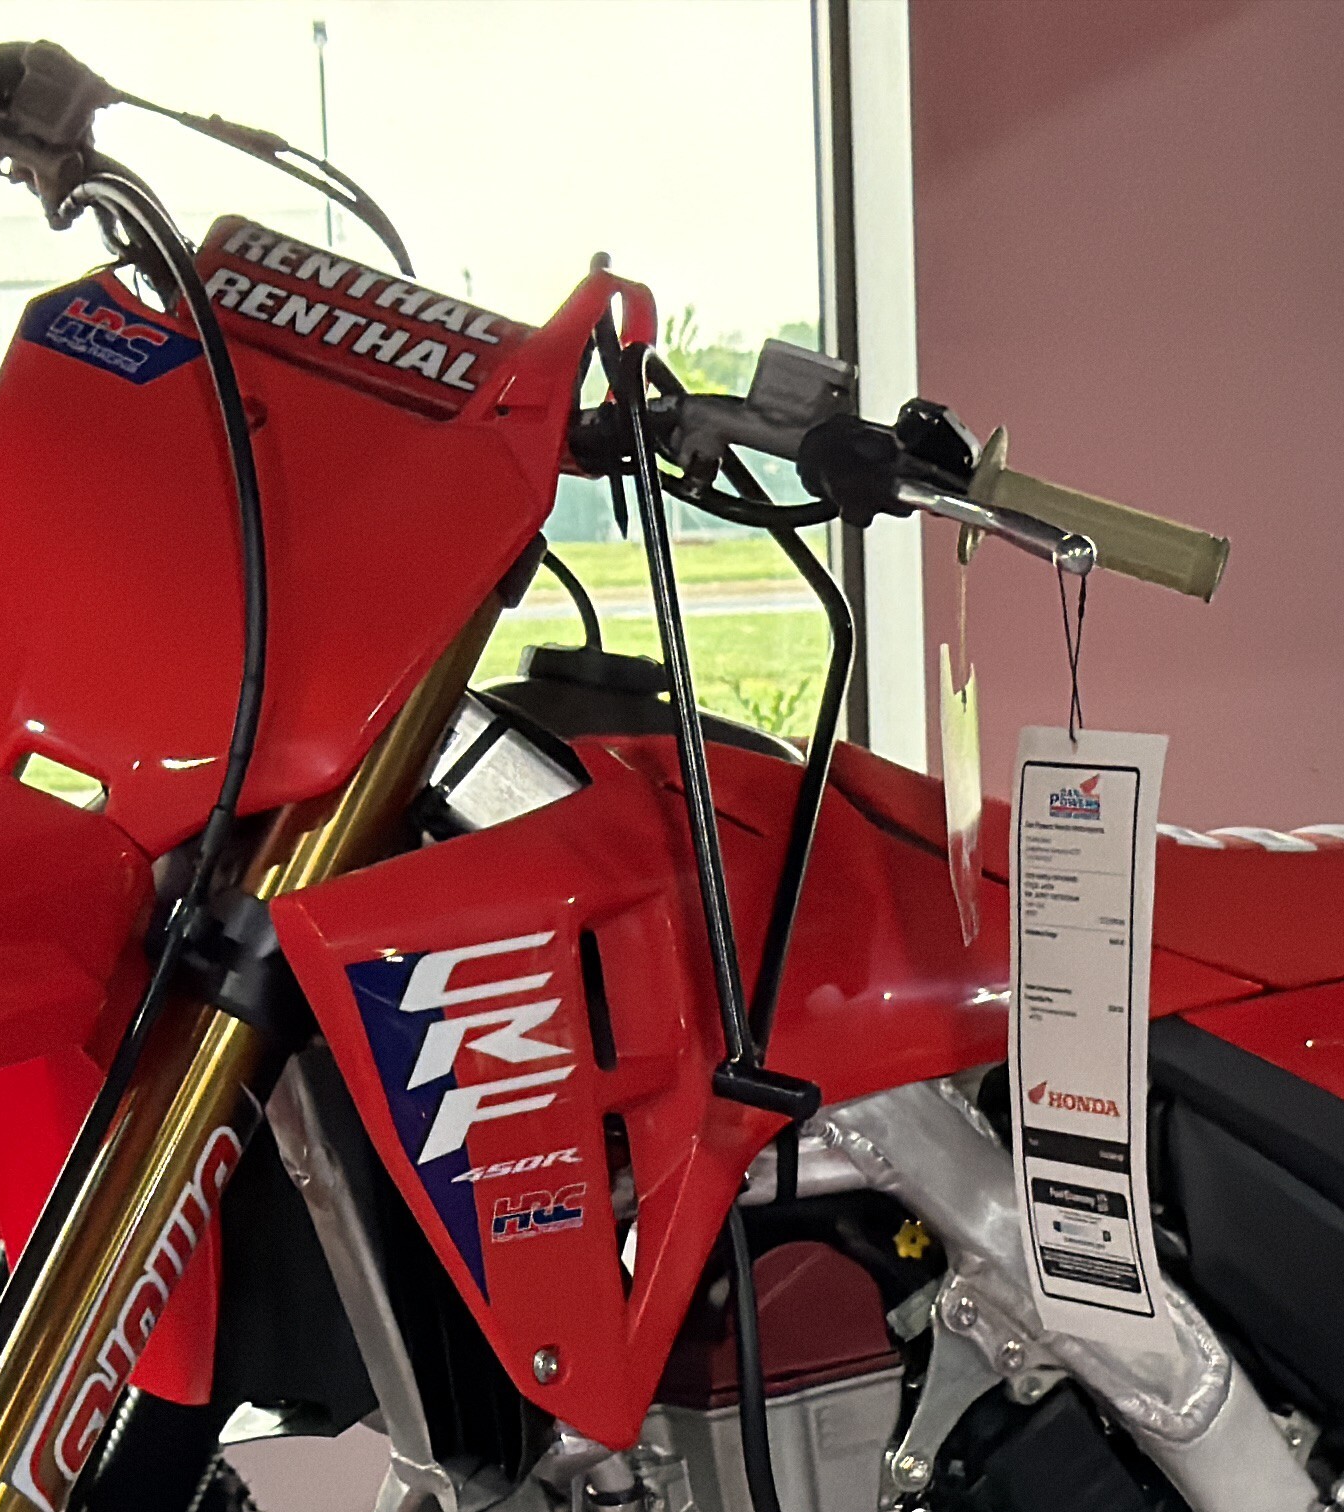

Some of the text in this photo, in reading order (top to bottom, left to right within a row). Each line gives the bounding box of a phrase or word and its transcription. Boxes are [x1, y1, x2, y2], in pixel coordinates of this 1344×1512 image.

[222, 224, 500, 345] RENTHAL
[46, 297, 169, 366] HRC
[206, 268, 476, 391] RENTHAL
[399, 930, 576, 1165] CRF
[1047, 1089, 1121, 1118] HONDA
[451, 1147, 583, 1183] 450R
[491, 1182, 587, 1234] HRC
